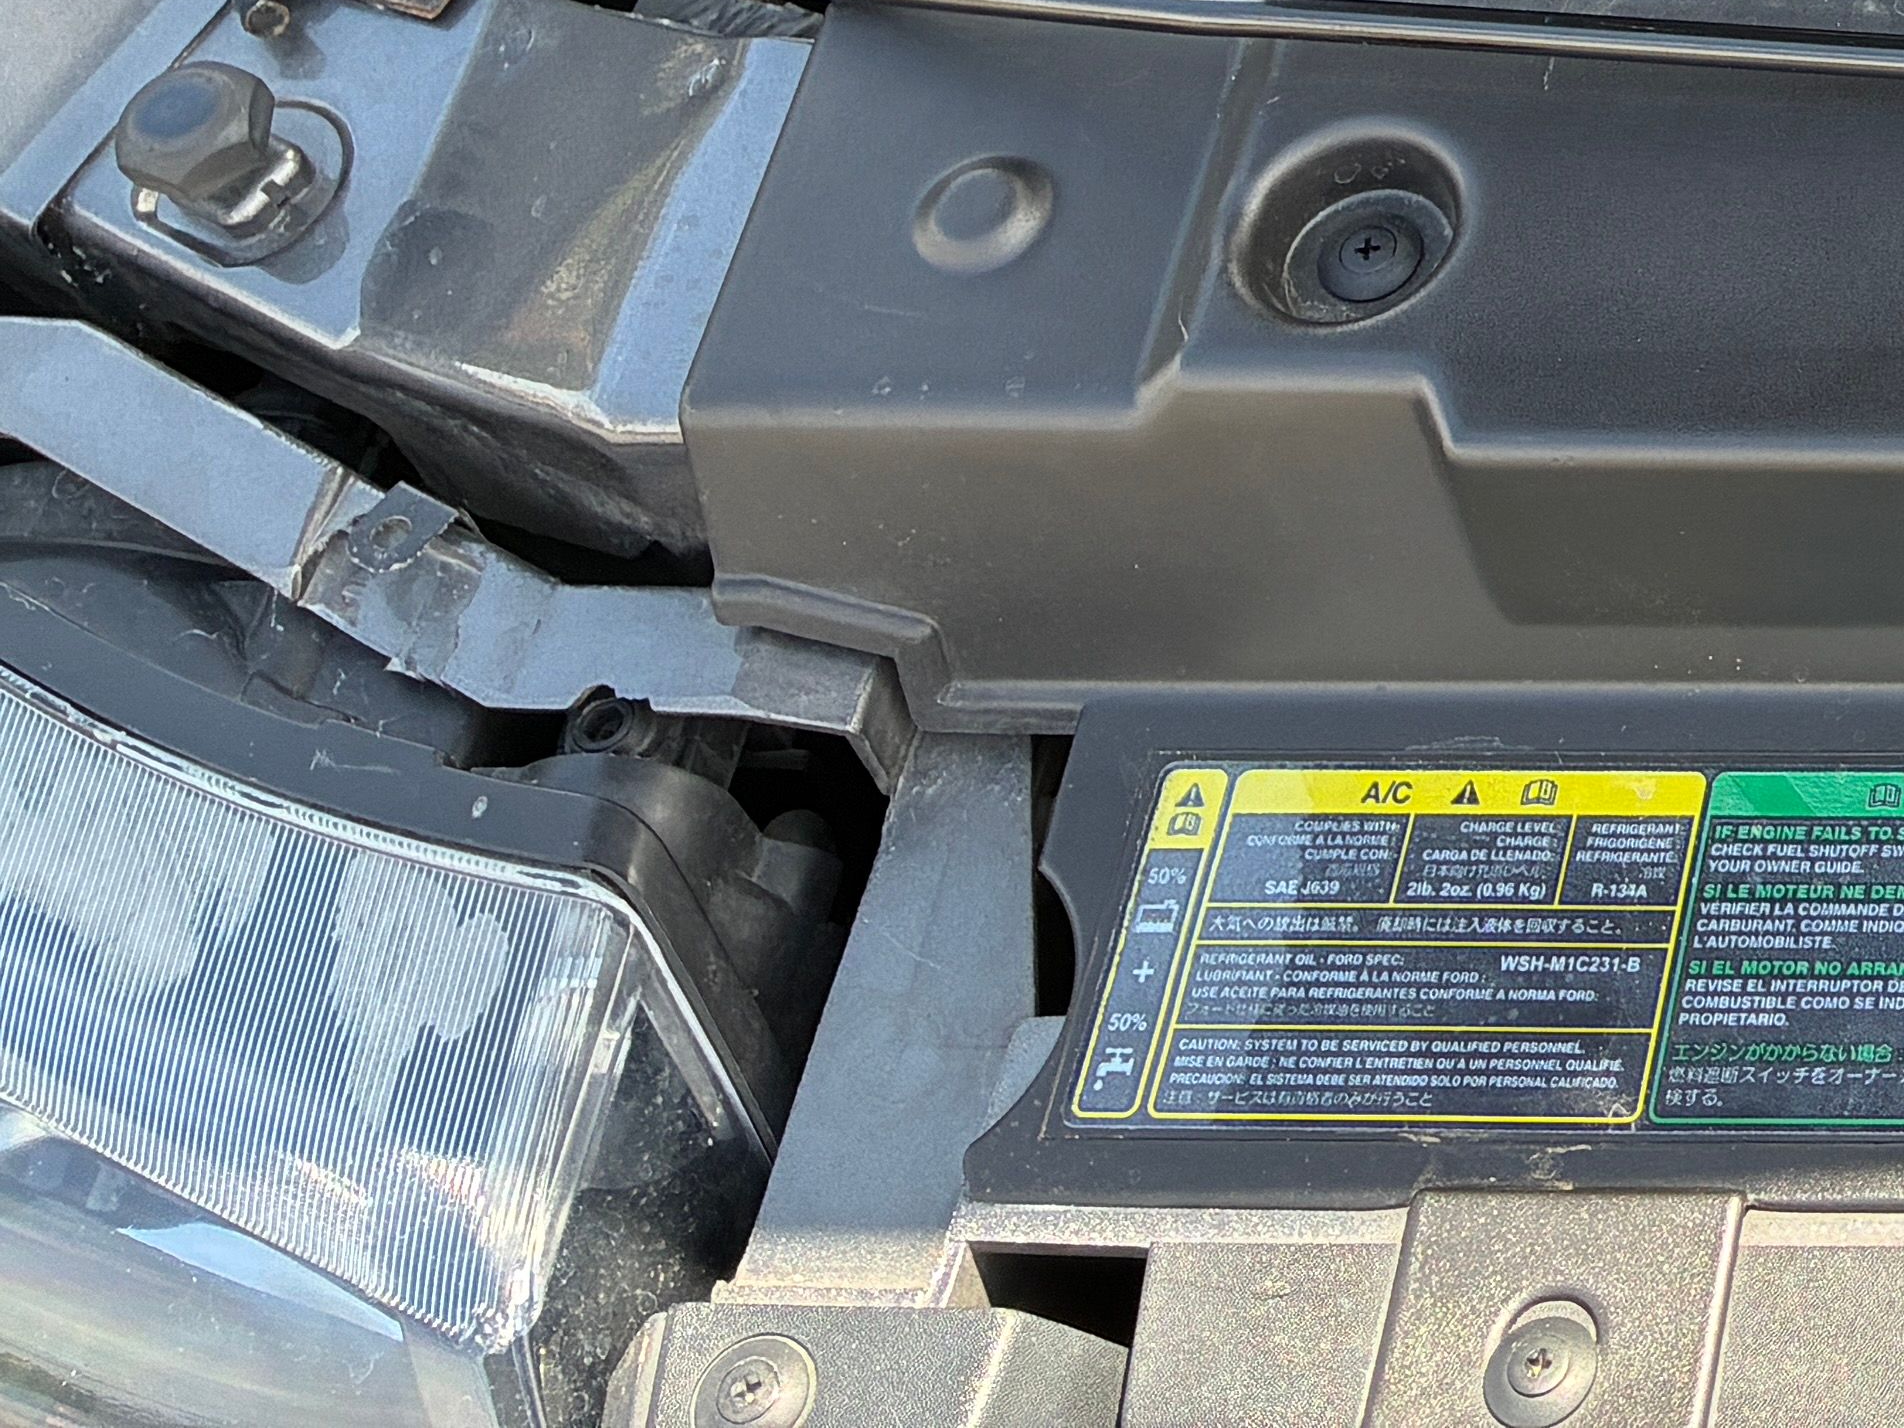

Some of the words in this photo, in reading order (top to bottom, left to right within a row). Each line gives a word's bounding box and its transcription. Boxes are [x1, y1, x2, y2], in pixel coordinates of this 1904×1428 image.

[1360, 780, 1414, 804] A/C
[1460, 821, 1513, 832] CHARGE
[1516, 822, 1561, 835] LEVEL:
[1715, 825, 1734, 841] IF
[1738, 825, 1806, 839] ENGINE
[1811, 826, 1860, 839] FAILS
[1868, 826, 1893, 839] TO
[1422, 849, 1467, 860] CARGA
[1470, 849, 1487, 860] DE
[1711, 843, 1762, 855] CHECK
[1766, 844, 1806, 856] FUEL
[1809, 844, 1878, 857] SHUTOFF
[1709, 859, 1750, 872] YOUR
[1754, 860, 1810, 872] OWNER
[1814, 861, 1864, 872] GUIDE.
[1147, 866, 1187, 884] 50%
[1264, 880, 1297, 894] SAE
[1300, 880, 1339, 894] J639
[1406, 881, 1435, 895] 2lb.
[1439, 882, 1471, 896] 2oz.
[1476, 882, 1514, 898] (0.96
[1518, 882, 1545, 899] Kg)
[1591, 883, 1649, 898] R-134A
[1703, 884, 1721, 897] SI
[1726, 884, 1749, 897] LE
[1755, 884, 1833, 898] MOTEUR
[1839, 885, 1865, 898] NE
[1773, 902, 1793, 915] LA
[1798, 903, 1888, 915] COMMANDE
[1800, 919, 1858, 932] COMME
[1200, 953, 1291, 964] REFRIGERANT
[1295, 954, 1316, 965] OIL
[1327, 954, 1362, 964] FORD
[1365, 954, 1404, 965] SPEC:
[1501, 955, 1641, 973] WSH-M1C231-B
[1688, 960, 1706, 974] SI
[1712, 960, 1734, 974] EL
[1741, 960, 1808, 974] MOTOR
[1814, 961, 1841, 974] NO
[1685, 979, 1742, 991] REVISE
[1746, 979, 1766, 991] EL
[1770, 979, 1882, 992] INTERRUPTOR
[1682, 996, 1795, 1008] COMBUSTIBLE
[1800, 996, 1849, 1008] COMO
[1853, 996, 1875, 1009] SE
[1107, 1013, 1148, 1032] 50%
[1678, 1012, 1790, 1027] PROPIETARIO.
[1244, 1039, 1297, 1050] SYSTEM
[1301, 1039, 1317, 1051] TO
[1320, 1039, 1338, 1051] BE
[1342, 1039, 1407, 1051] SERVICED
[1410, 1040, 1429, 1051] BY
[1431, 1041, 1500, 1052] QUALIFIED
